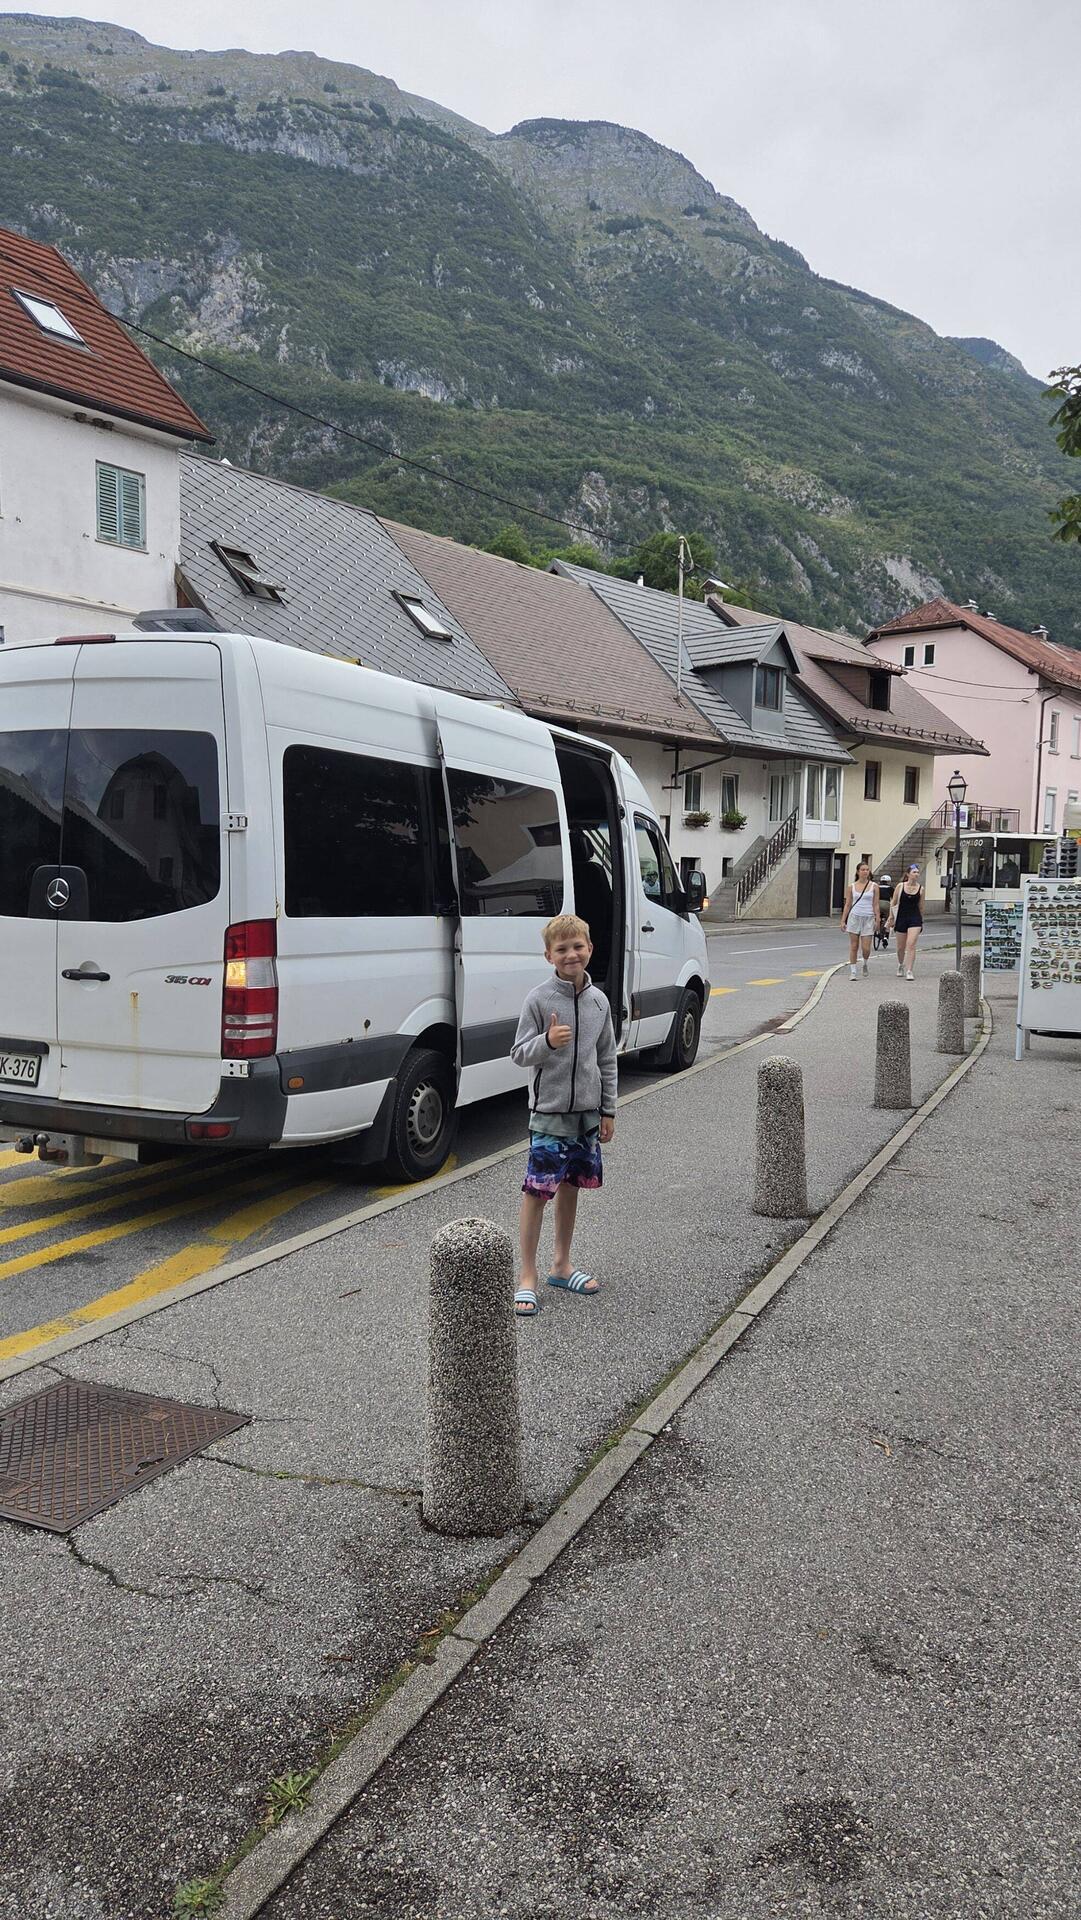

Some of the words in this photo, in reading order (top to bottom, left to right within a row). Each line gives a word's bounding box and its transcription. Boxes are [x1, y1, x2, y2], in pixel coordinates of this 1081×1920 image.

[164, 974, 188, 984] 315
[188, 976, 212, 986] CDI
[0, 1056, 36, 1078] K-376
